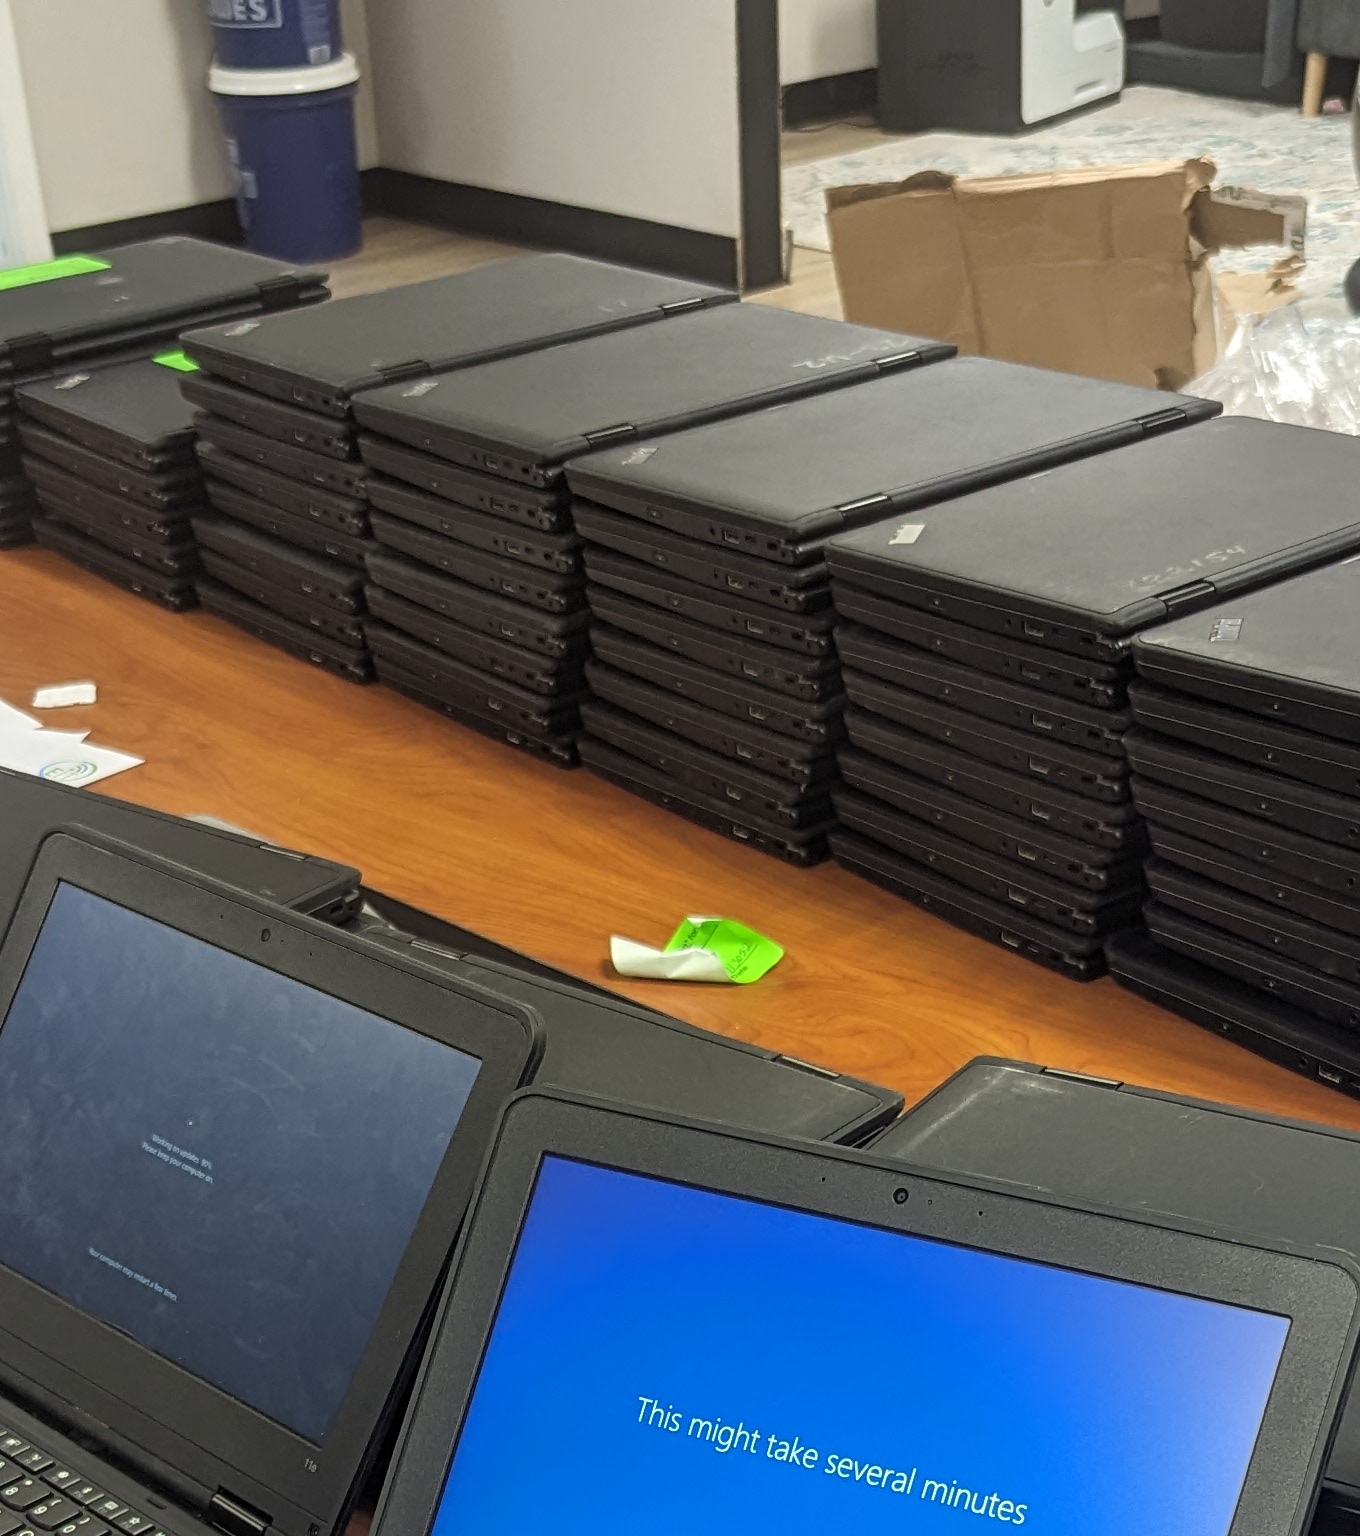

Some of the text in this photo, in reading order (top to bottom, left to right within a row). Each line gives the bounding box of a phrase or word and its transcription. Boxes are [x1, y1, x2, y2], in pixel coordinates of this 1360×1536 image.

[638, 1396, 1028, 1526] This might take several minutes
